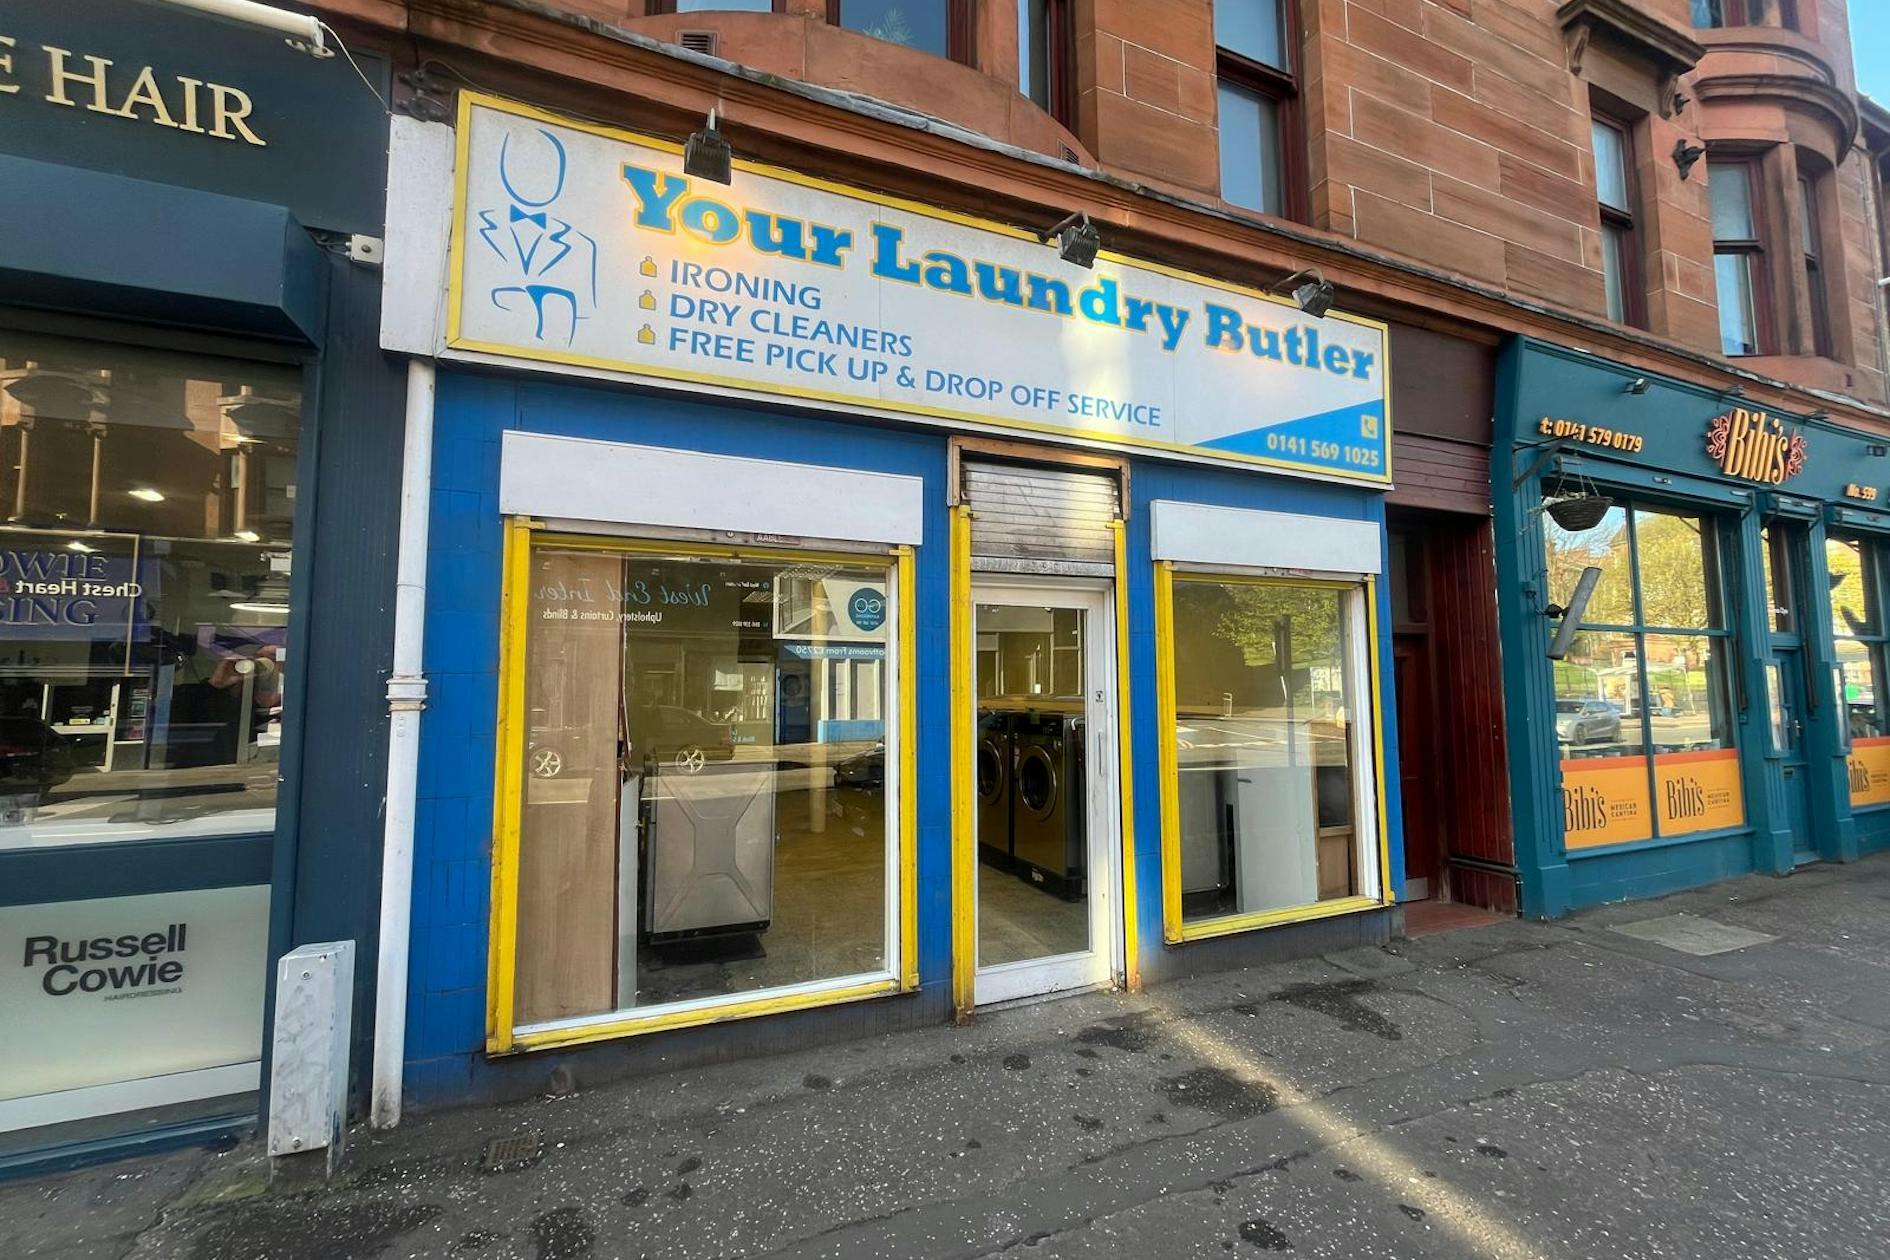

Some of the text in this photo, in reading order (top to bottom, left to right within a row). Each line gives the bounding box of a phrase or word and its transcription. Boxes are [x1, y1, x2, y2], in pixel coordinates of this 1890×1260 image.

[42, 45, 267, 147] HAIR
[620, 161, 1376, 382] Your Laundry Butler
[670, 259, 822, 310] IRONING
[669, 293, 913, 358] DRY CLEANERS
[669, 327, 1161, 427] FREE PICK UP & DROP OFF SERVICE
[1267, 432, 1379, 466] 0141 569 1025
[1539, 416, 1644, 453] t: 0141 579 0179
[1724, 406, 1789, 485] Bibi's
[1849, 759, 1870, 792] ibi's
[1563, 786, 1607, 832] Bibi's
[1666, 778, 1705, 821] Bibi's
[24, 923, 187, 967] Russell
[43, 956, 184, 996] Cowie
